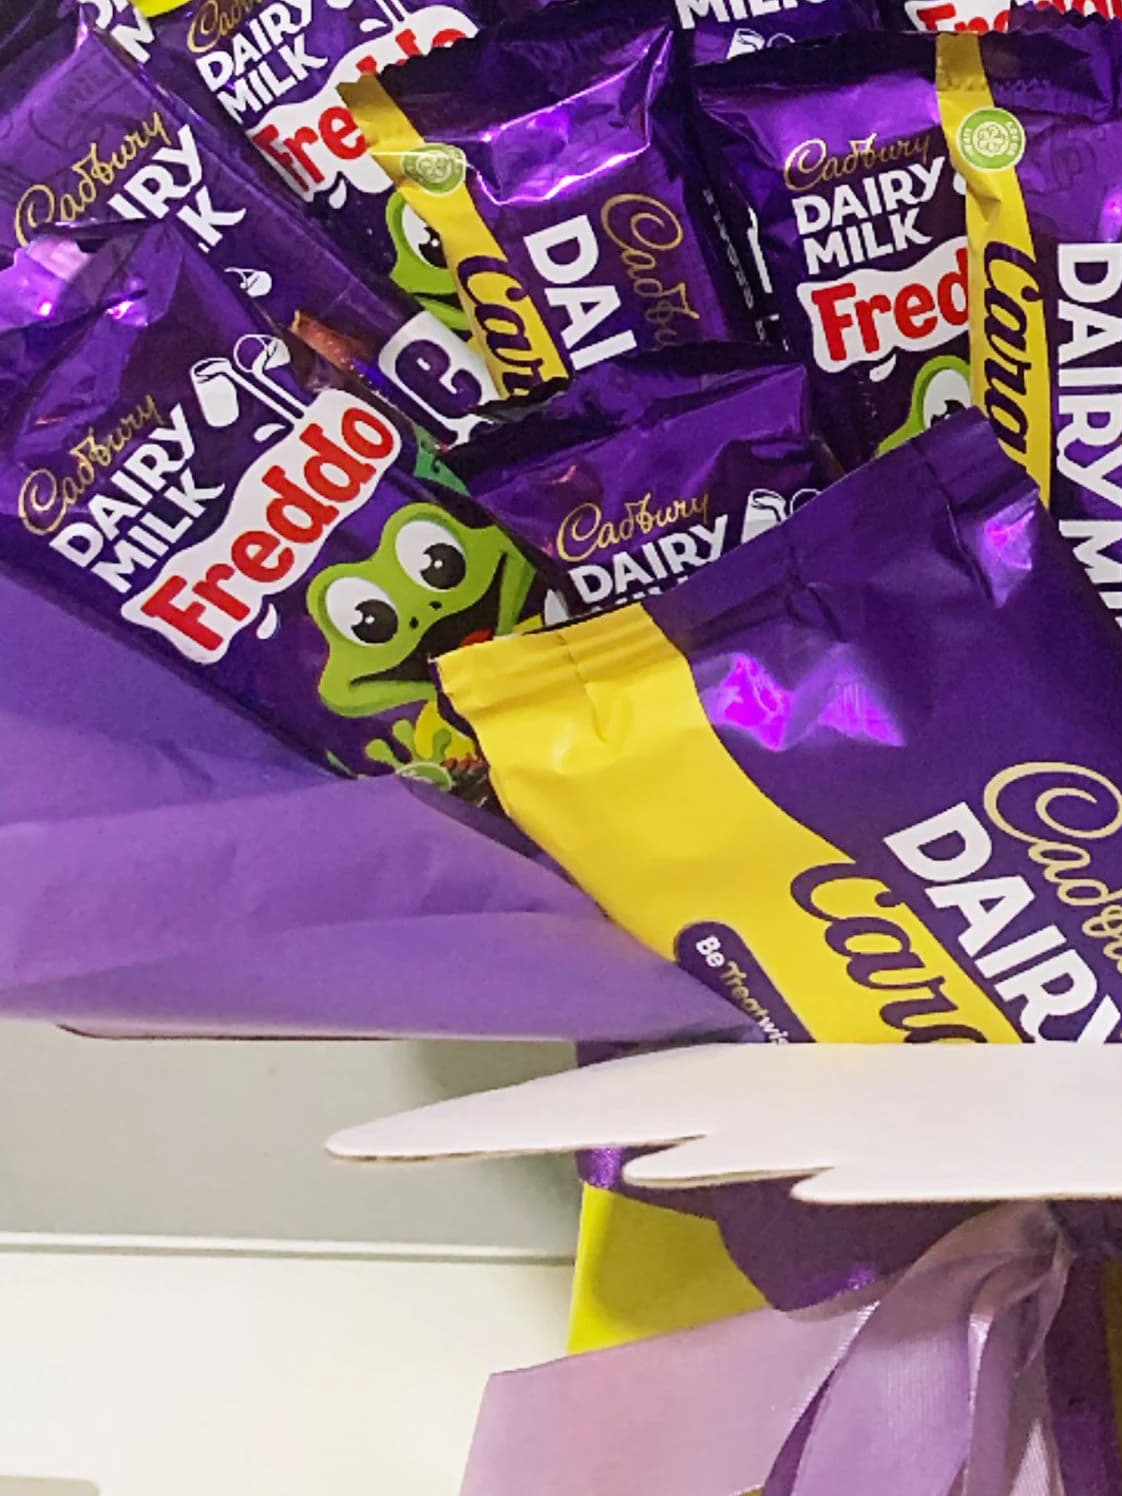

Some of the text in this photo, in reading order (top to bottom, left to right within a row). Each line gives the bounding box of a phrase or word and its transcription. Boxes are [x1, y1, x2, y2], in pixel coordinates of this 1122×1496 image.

[217, 39, 329, 126] MILK
[14, 111, 171, 246] Cadbury
[108, 124, 204, 220] IRY
[784, 132, 932, 191] Cadbury
[791, 156, 945, 236] DAIRY
[524, 215, 638, 371] DAI
[803, 207, 933, 275] MILK
[811, 247, 969, 362] Fred
[984, 241, 1043, 455] Cara
[18, 395, 168, 536] Cadbury
[50, 403, 195, 567] DAIRY
[90, 463, 226, 594] MILK
[141, 407, 394, 651] Freddo
[557, 493, 710, 562] Cadbury
[569, 515, 728, 604] DAIRY
[696, 935, 725, 967] Be
